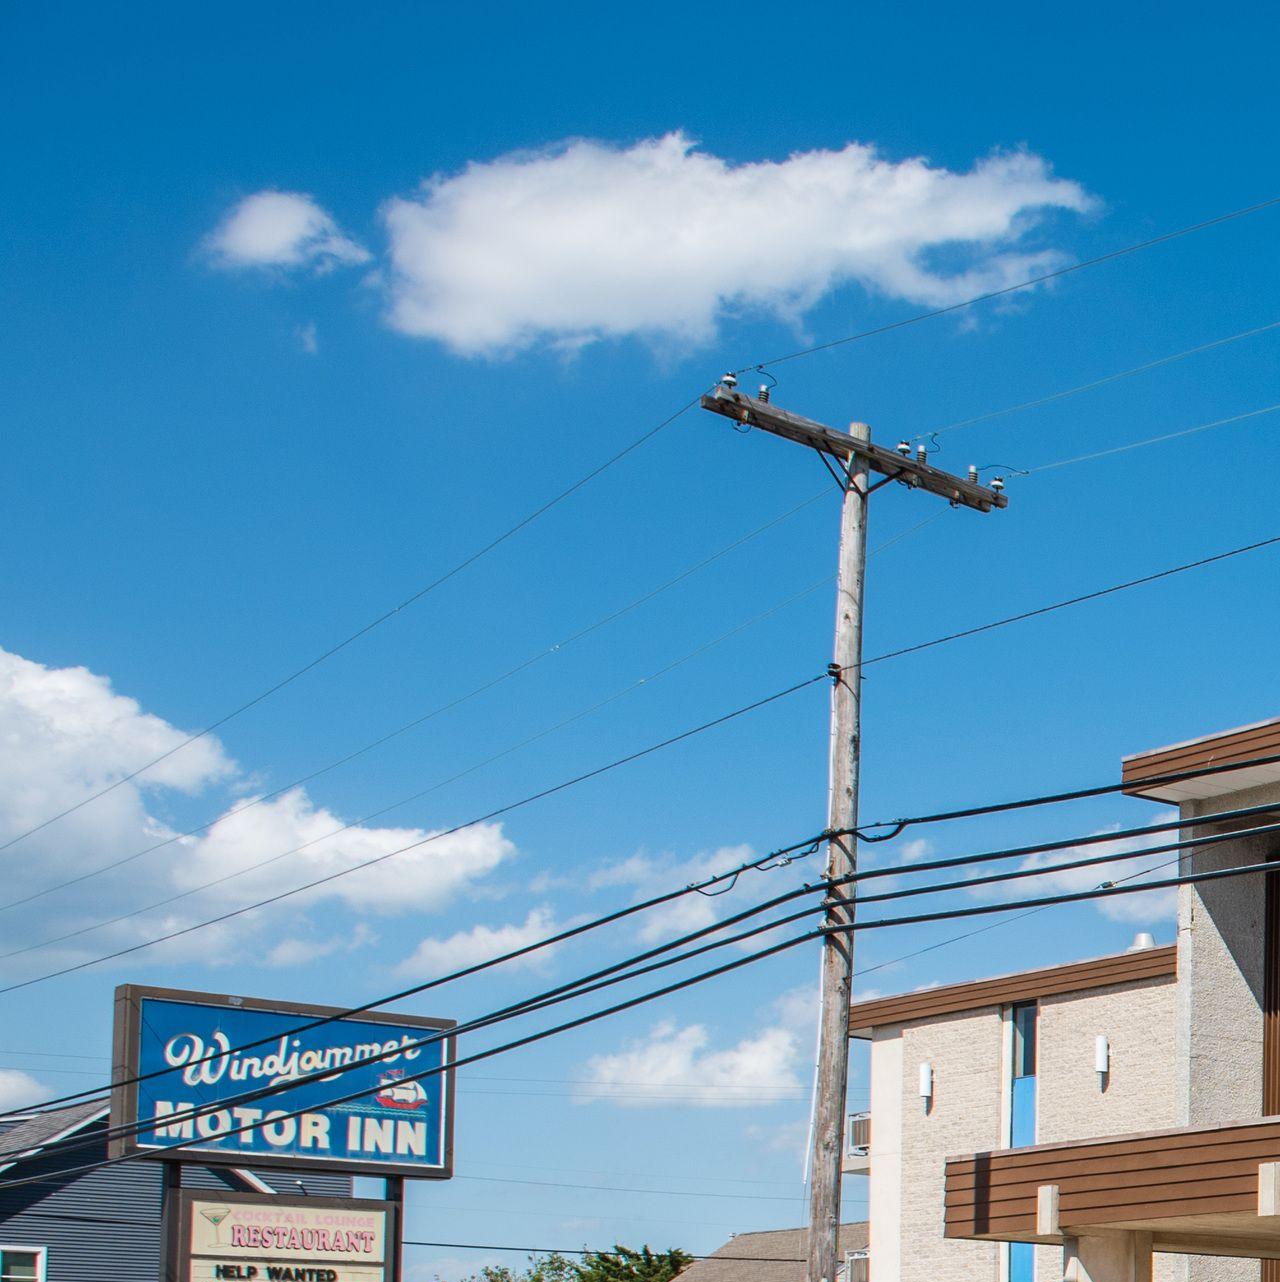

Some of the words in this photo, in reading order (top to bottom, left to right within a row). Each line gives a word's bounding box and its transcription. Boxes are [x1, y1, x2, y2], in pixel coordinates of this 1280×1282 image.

[164, 1031, 421, 1095] Windjammer
[154, 1100, 330, 1149] MOTOR
[348, 1116, 427, 1156] INN
[232, 1210, 308, 1225] COCKTAIL
[316, 1213, 376, 1228] LOUNGE
[231, 1224, 376, 1253] RESTAURANT
[215, 1264, 258, 1281] HELP
